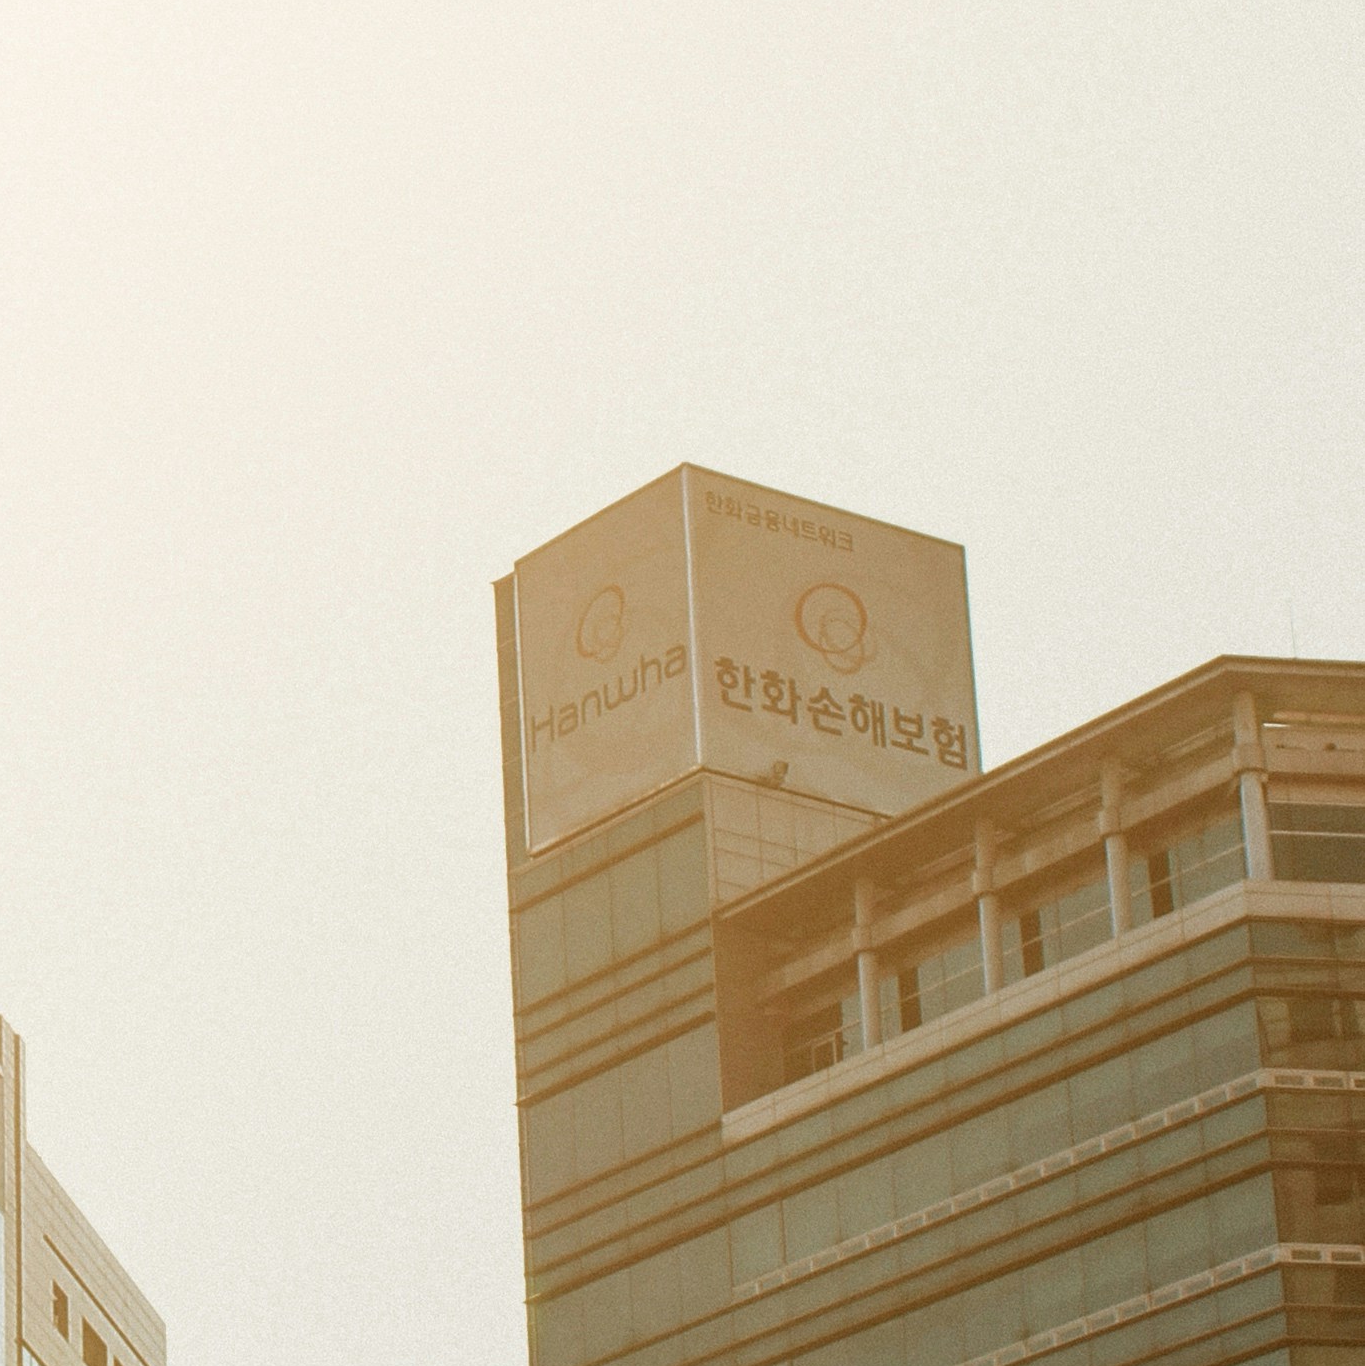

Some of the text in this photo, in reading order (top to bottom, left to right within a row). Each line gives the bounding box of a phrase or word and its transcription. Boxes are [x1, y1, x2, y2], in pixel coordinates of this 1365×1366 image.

[704, 490, 855, 553] 한화금융네트워크
[529, 642, 688, 753] Hanwha
[714, 655, 969, 771] 한화손해보험
